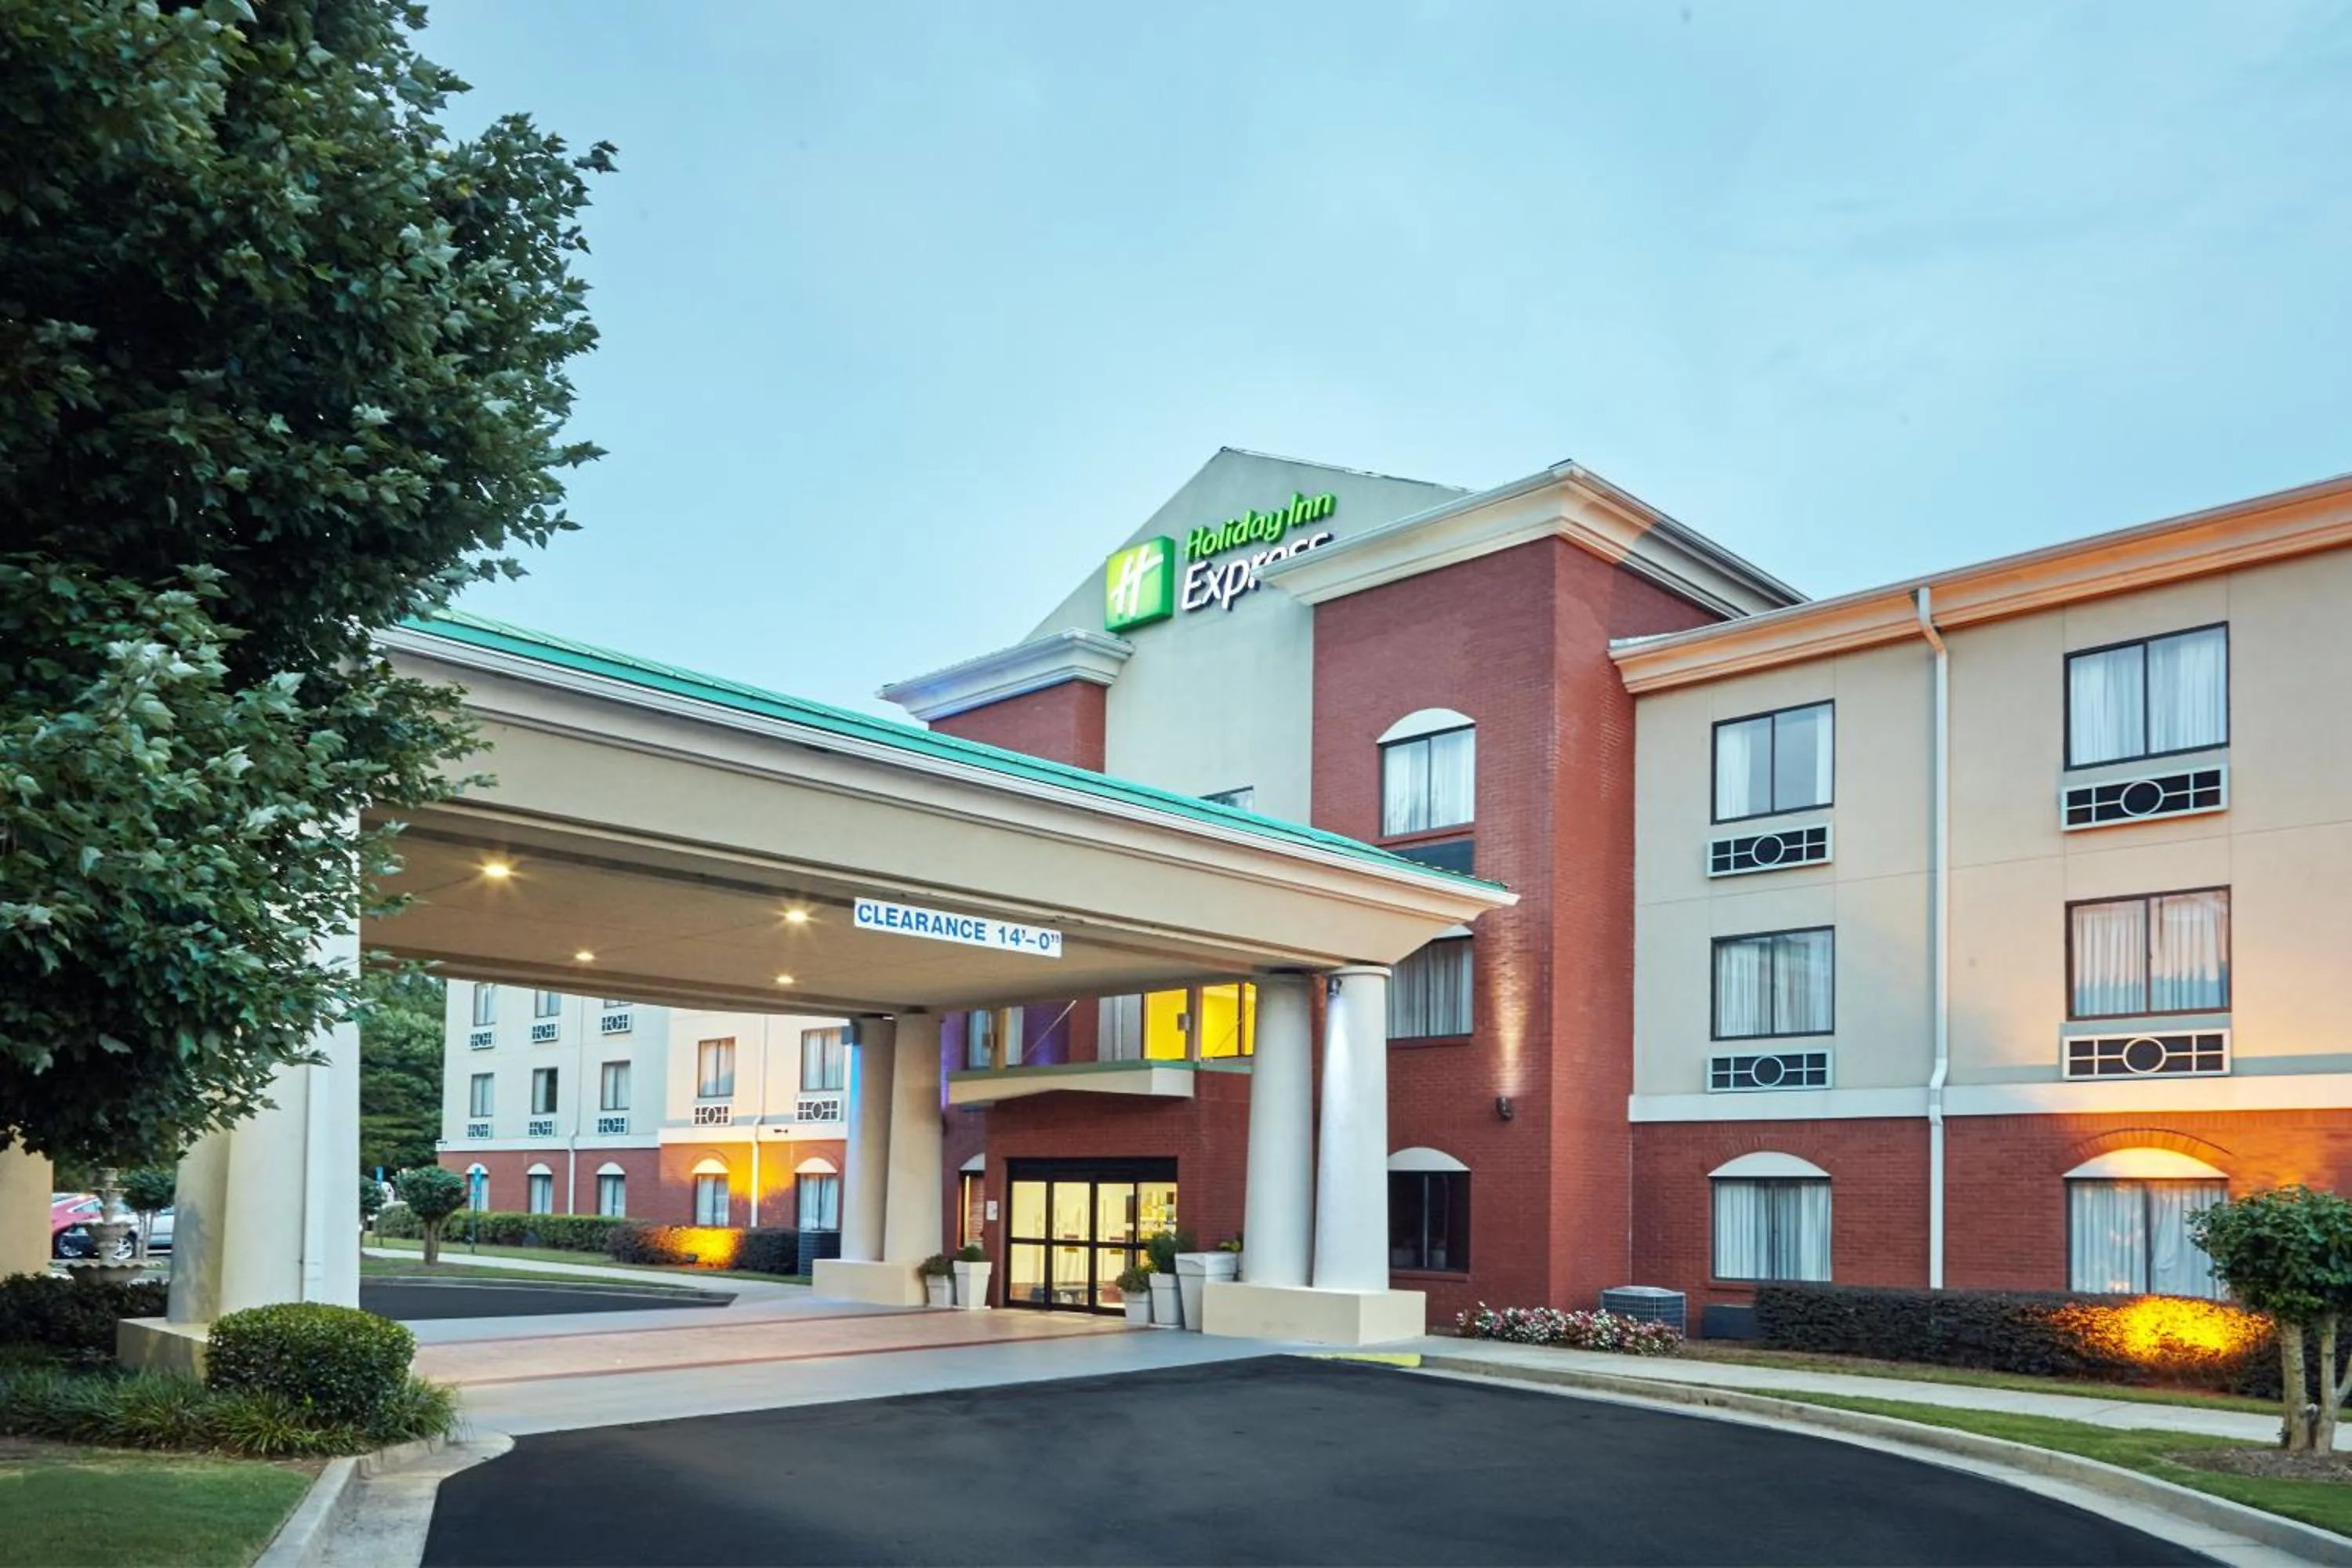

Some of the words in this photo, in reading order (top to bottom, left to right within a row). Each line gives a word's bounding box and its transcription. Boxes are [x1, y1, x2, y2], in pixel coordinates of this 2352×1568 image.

[1185, 510, 1287, 561] Holiday
[1287, 492, 1335, 526] Inn
[858, 904, 986, 941] CLEARANCE
